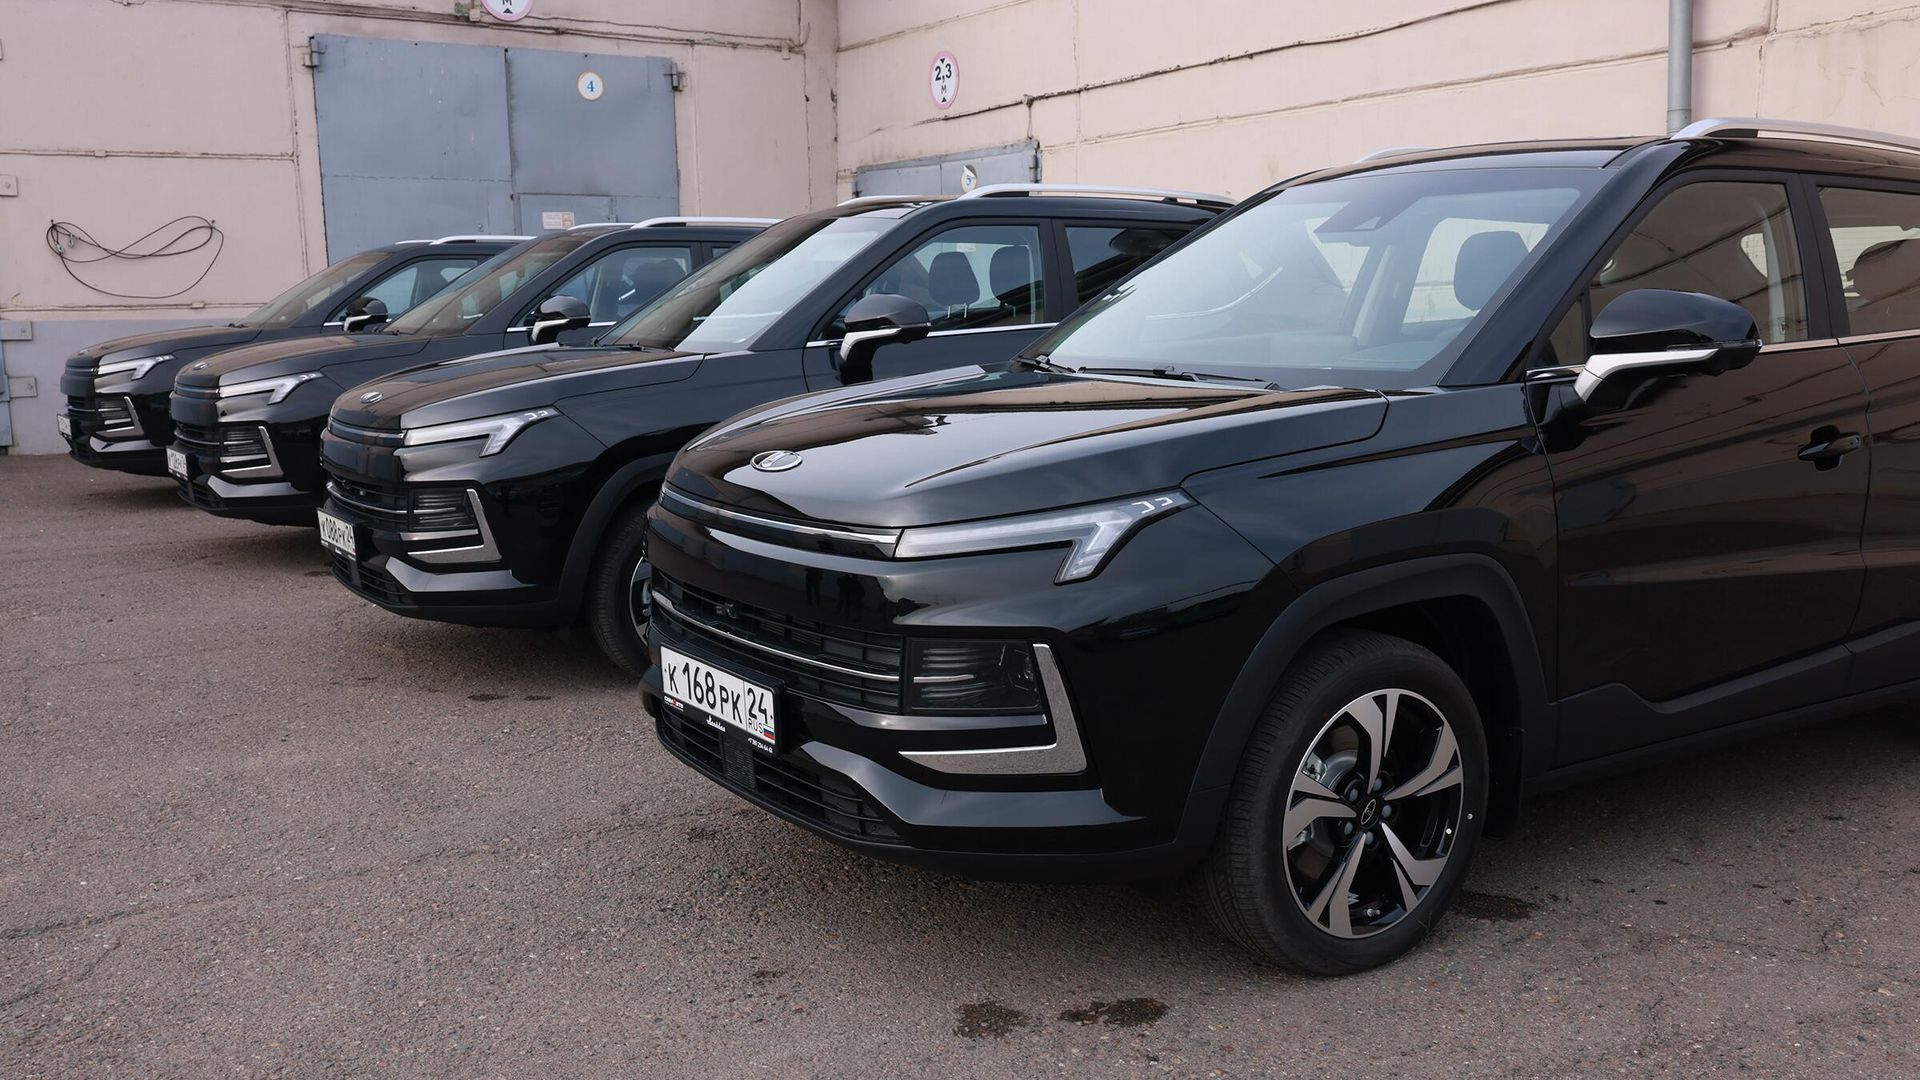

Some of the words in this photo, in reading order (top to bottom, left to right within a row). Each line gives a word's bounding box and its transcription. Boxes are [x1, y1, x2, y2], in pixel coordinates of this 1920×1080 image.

[935, 63, 952, 83] 2,3
[586, 81, 595, 92] 4
[941, 84, 947, 94] М
[747, 688, 768, 724] 24
[748, 718, 763, 734] RUS
